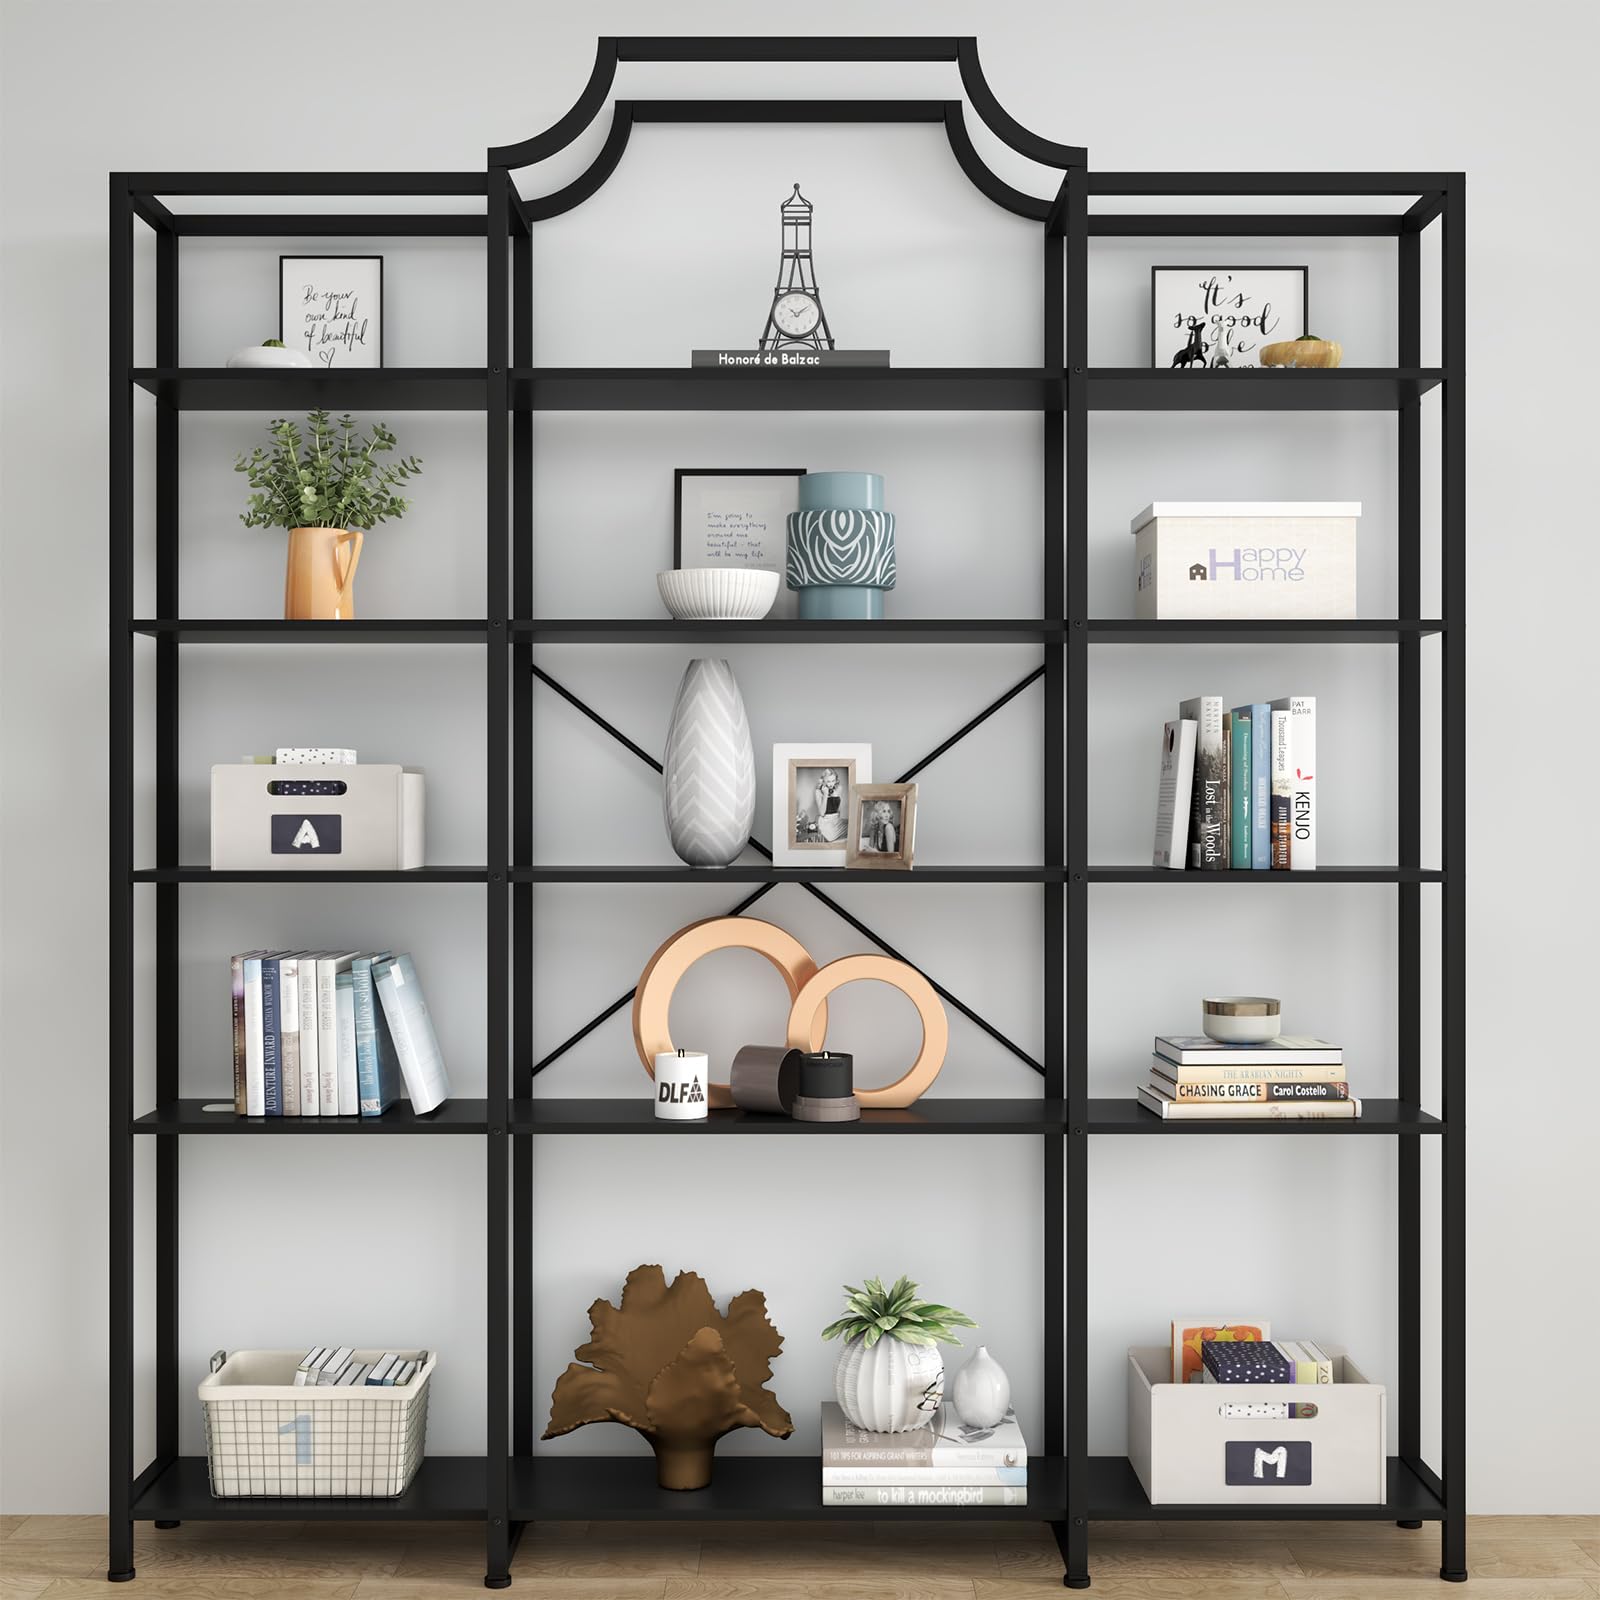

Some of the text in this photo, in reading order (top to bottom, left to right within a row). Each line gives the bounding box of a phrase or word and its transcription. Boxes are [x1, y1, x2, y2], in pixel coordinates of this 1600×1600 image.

[303, 285, 354, 311] Be your
[1199, 275, 1252, 314] It's
[304, 297, 359, 323] own kind
[1173, 303, 1281, 342] so good
[304, 318, 369, 352] of beautiful
[718, 353, 820, 365] Honoré de Balzac
[1292, 708, 1312, 716] BARR
[1278, 716, 1286, 746] Thousand
[1277, 746, 1286, 772] Leagues
[1205, 780, 1220, 804] Lost
[1295, 791, 1310, 840] KENJO
[291, 818, 321, 849] A
[1205, 823, 1221, 863] Woods
[353, 969, 371, 1030] alice sebold
[265, 1006, 274, 1034] JONATHAN
[264, 1034, 277, 1112] ADVENTURE INWARD
[361, 1055, 374, 1075] lovely
[1223, 1070, 1304, 1079] THE ARABIAN NIGHTS
[658, 1082, 690, 1104] DLF
[1179, 1085, 1262, 1097] CHASING GRACE
[1272, 1085, 1294, 1096] Carol
[1295, 1085, 1327, 1096] Costello
[279, 1414, 312, 1465] 1
[1253, 1446, 1288, 1479] M
[832, 1488, 865, 1502] harper lee
[878, 1487, 983, 1506] to kill a mockingbird
